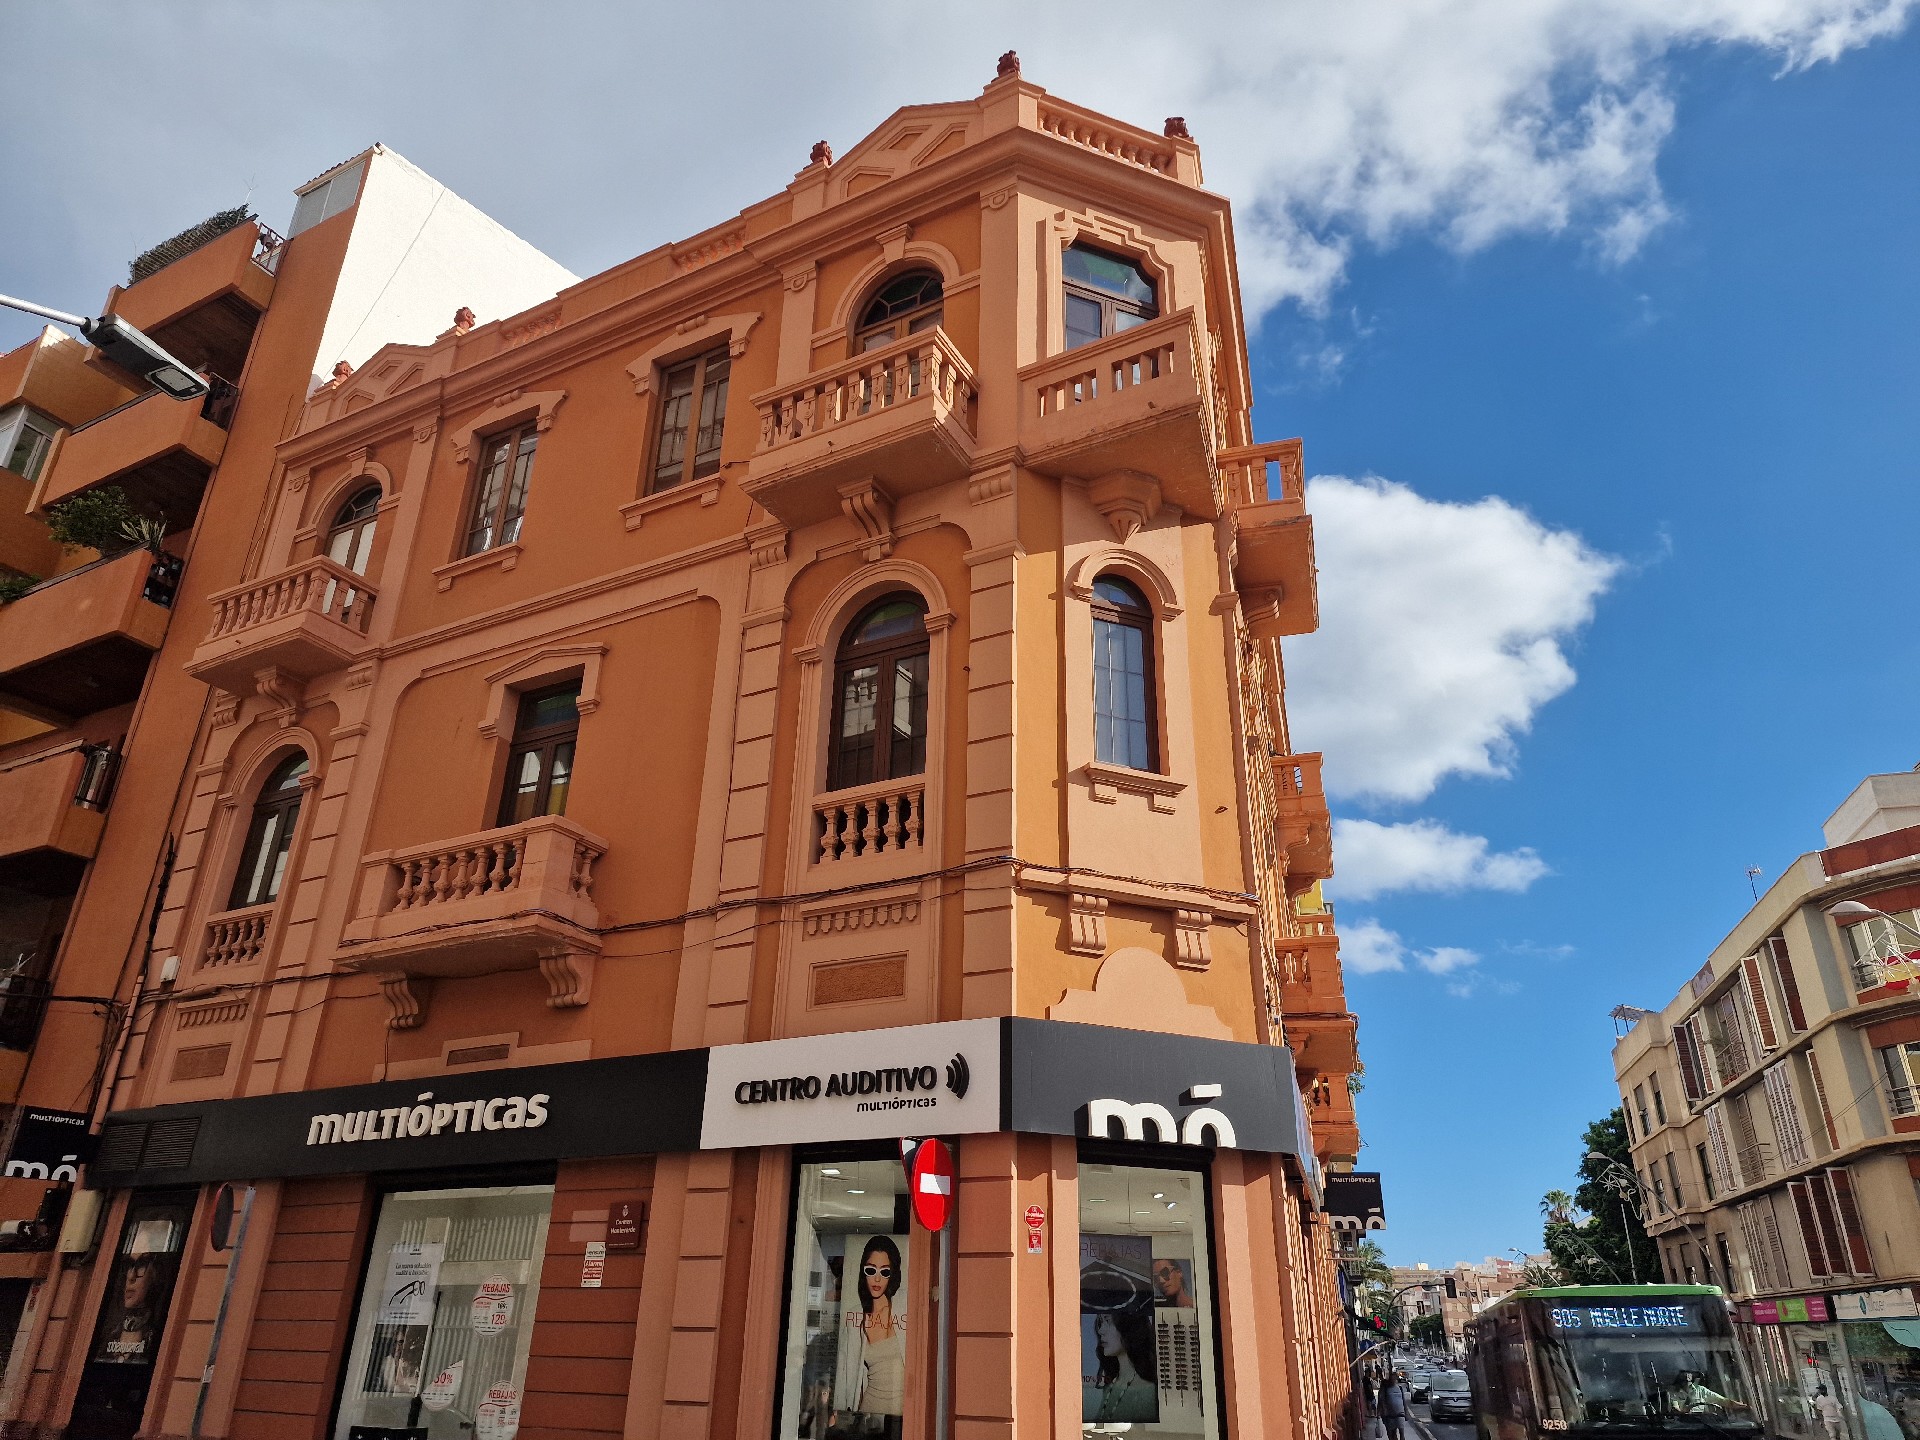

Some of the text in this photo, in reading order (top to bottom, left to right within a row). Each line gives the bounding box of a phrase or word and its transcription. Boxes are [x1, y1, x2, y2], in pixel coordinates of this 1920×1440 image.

[735, 1065, 938, 1104] CENTRO AUDITIVO
[481, 1283, 511, 1293] REBAJAS
[845, 1311, 908, 1331] REBAJAS
[1550, 1307, 1582, 1328] 905
[488, 1389, 518, 1400] REBAJAS
